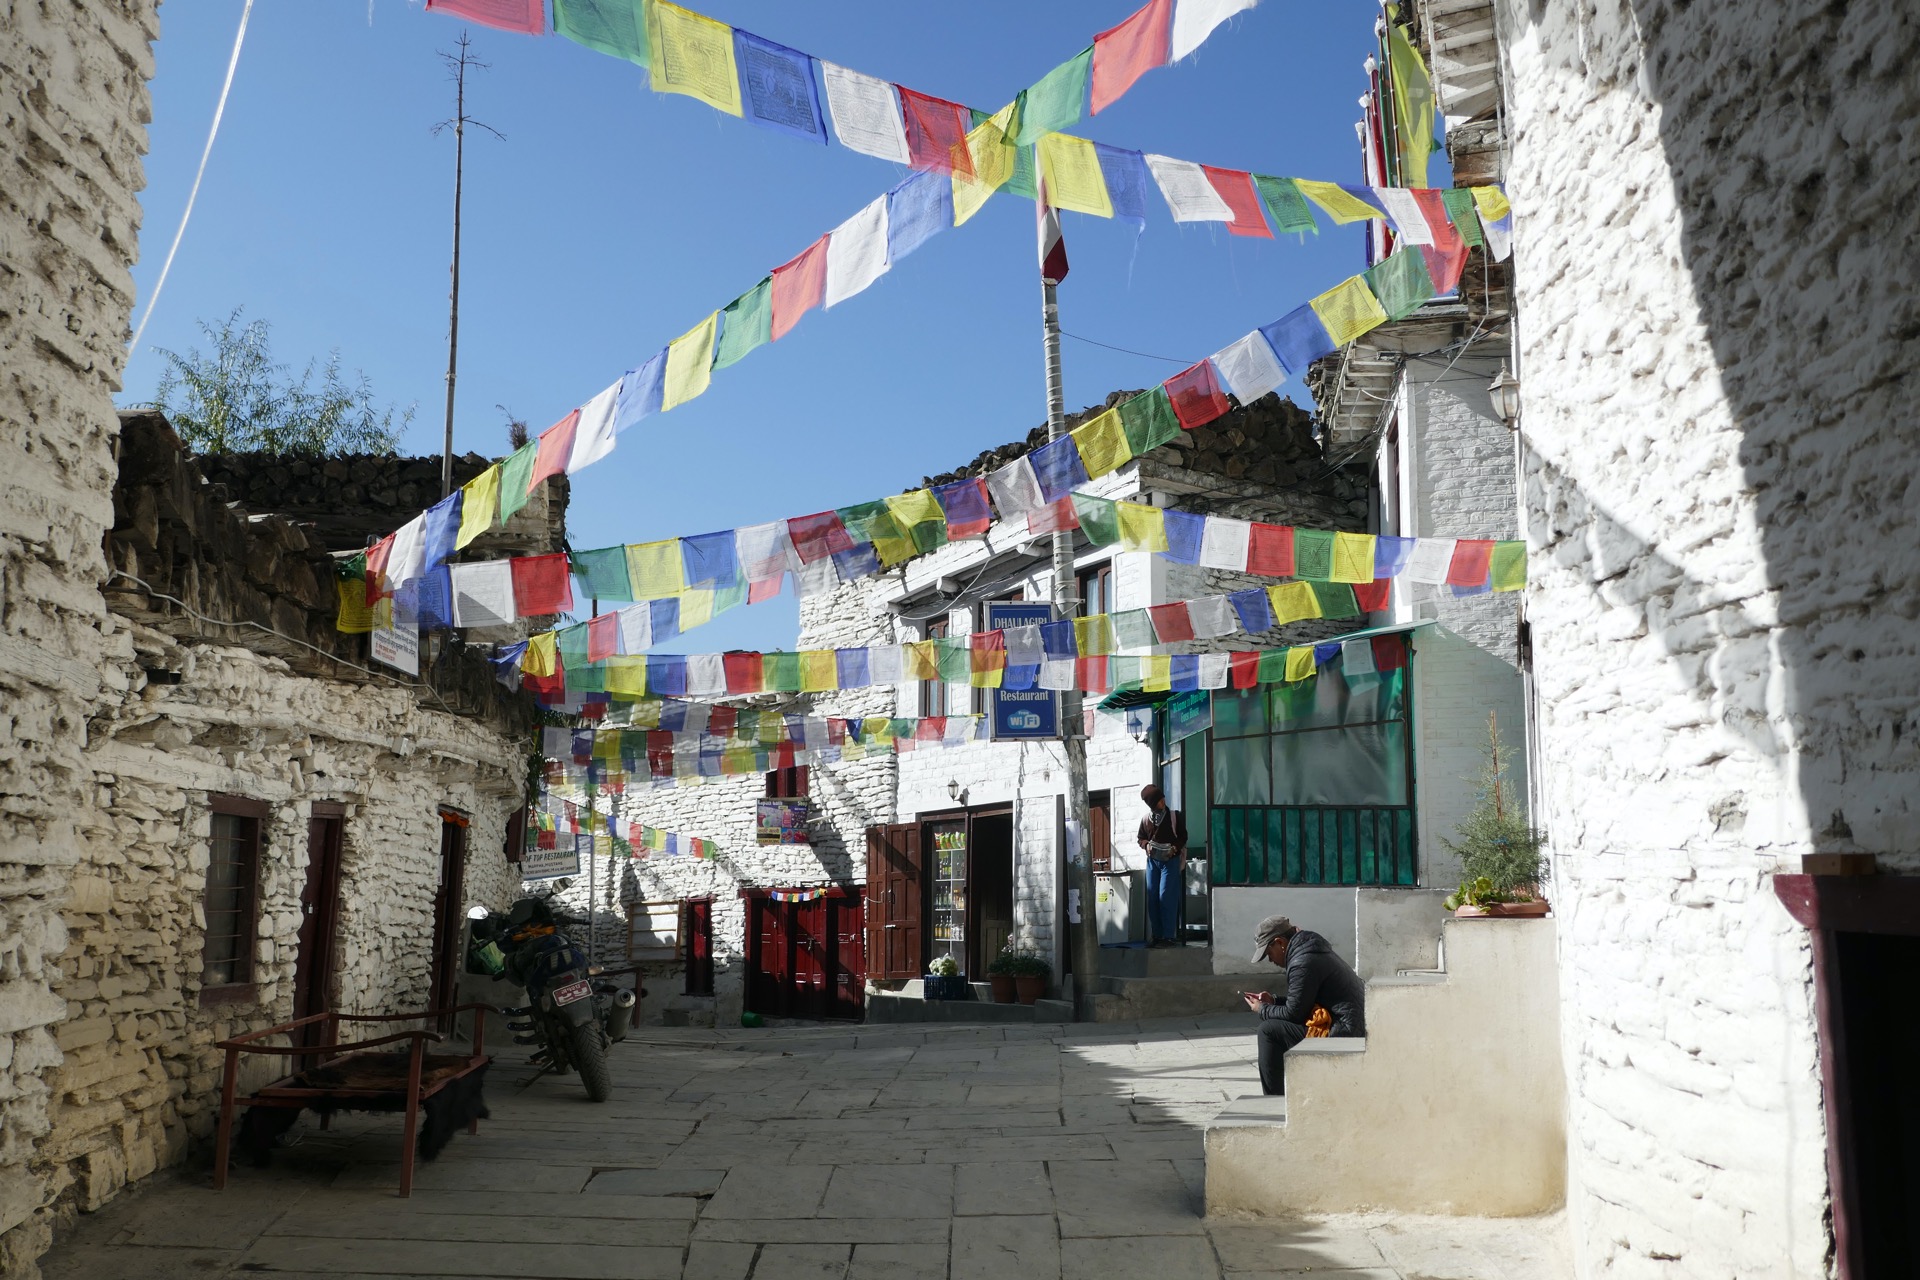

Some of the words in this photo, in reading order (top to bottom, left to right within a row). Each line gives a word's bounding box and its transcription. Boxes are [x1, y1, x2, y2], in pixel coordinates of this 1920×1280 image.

[994, 617, 1047, 629] DHAULAGIRI
[1000, 690, 1049, 702] Restaurant
[538, 842, 555, 850] SUN
[544, 852, 576, 860] RESTAURANT
